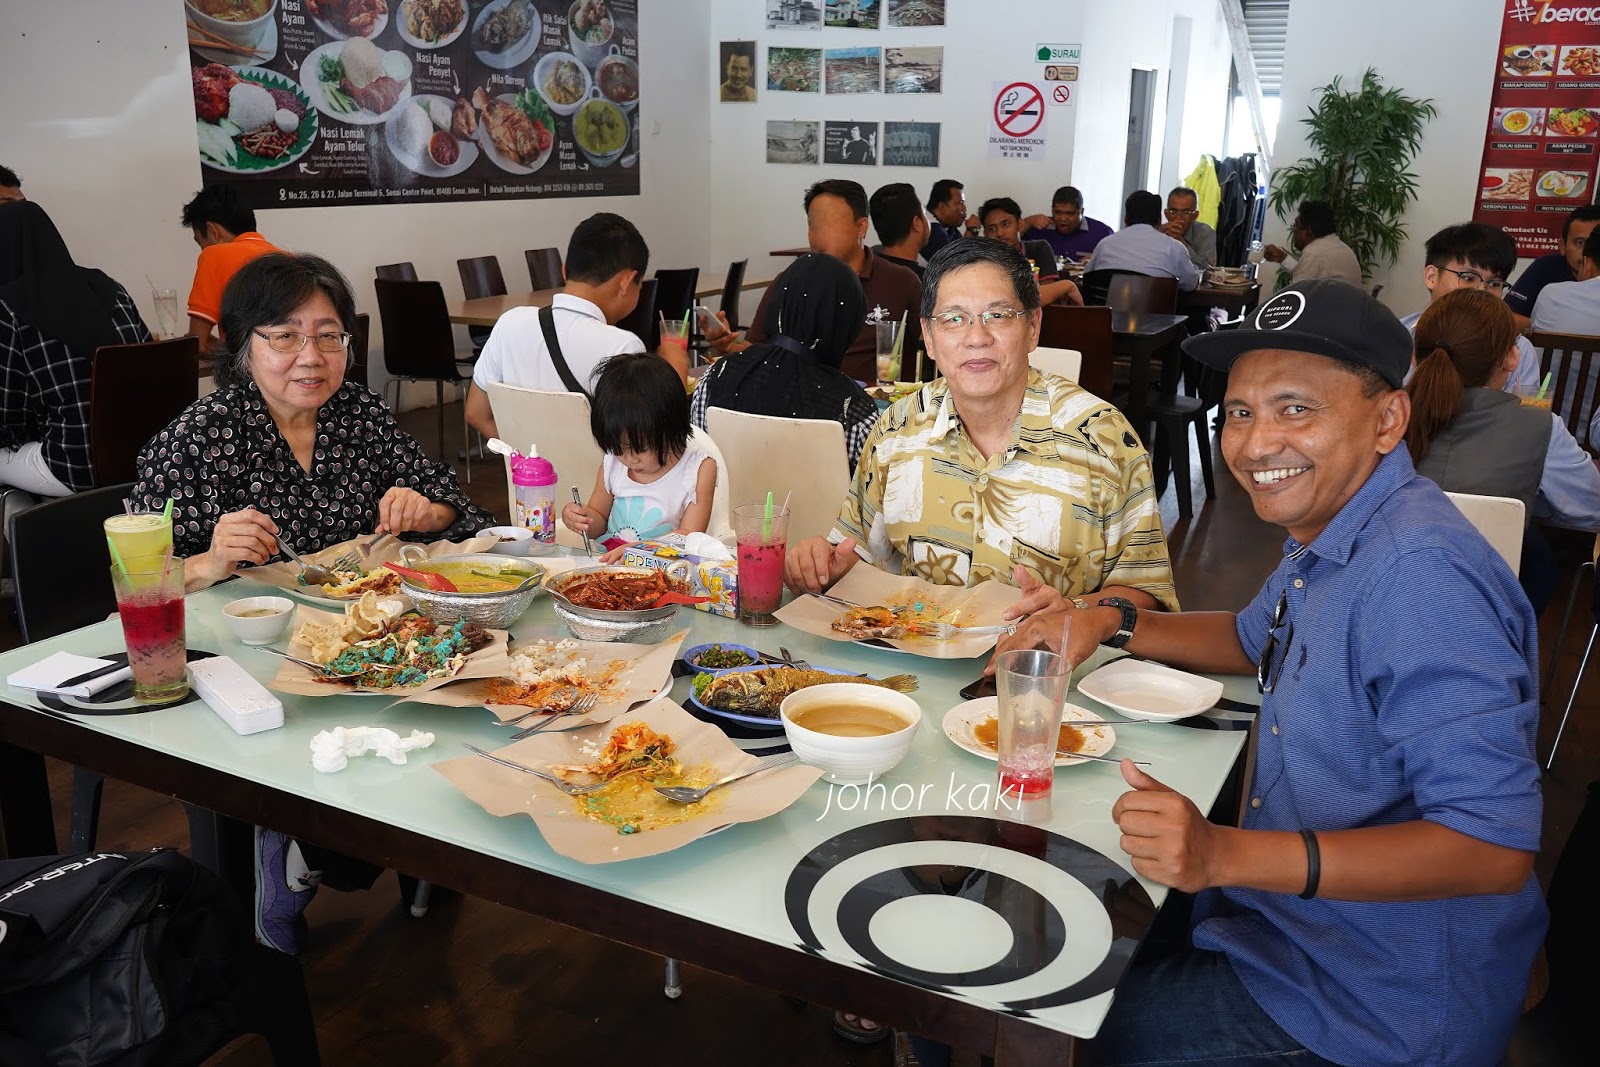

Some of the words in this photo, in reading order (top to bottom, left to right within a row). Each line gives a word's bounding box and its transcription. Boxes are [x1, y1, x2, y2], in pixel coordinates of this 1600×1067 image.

[281, 0, 300, 11] Nasi
[282, 11, 305, 26] Ayam
[544, 36, 561, 47] Lemak
[416, 52, 432, 63] Nasi
[433, 53, 451, 67] Ayam
[1052, 49, 1080, 59] SURAU
[429, 66, 451, 79] Penyet
[492, 74, 504, 84] Nila
[505, 75, 525, 88] Goreng
[320, 127, 338, 138] Nasi
[340, 127, 365, 139] Lemak
[324, 140, 346, 153] Ayam
[347, 141, 366, 152] Telur
[559, 151, 577, 160] Masak
[560, 161, 577, 170] Lemak
[311, 190, 320, 199] 26
[321, 190, 326, 198] &
[338, 189, 353, 198] Jalan
[354, 189, 378, 197] Terminal
[402, 188, 419, 196] Centre
